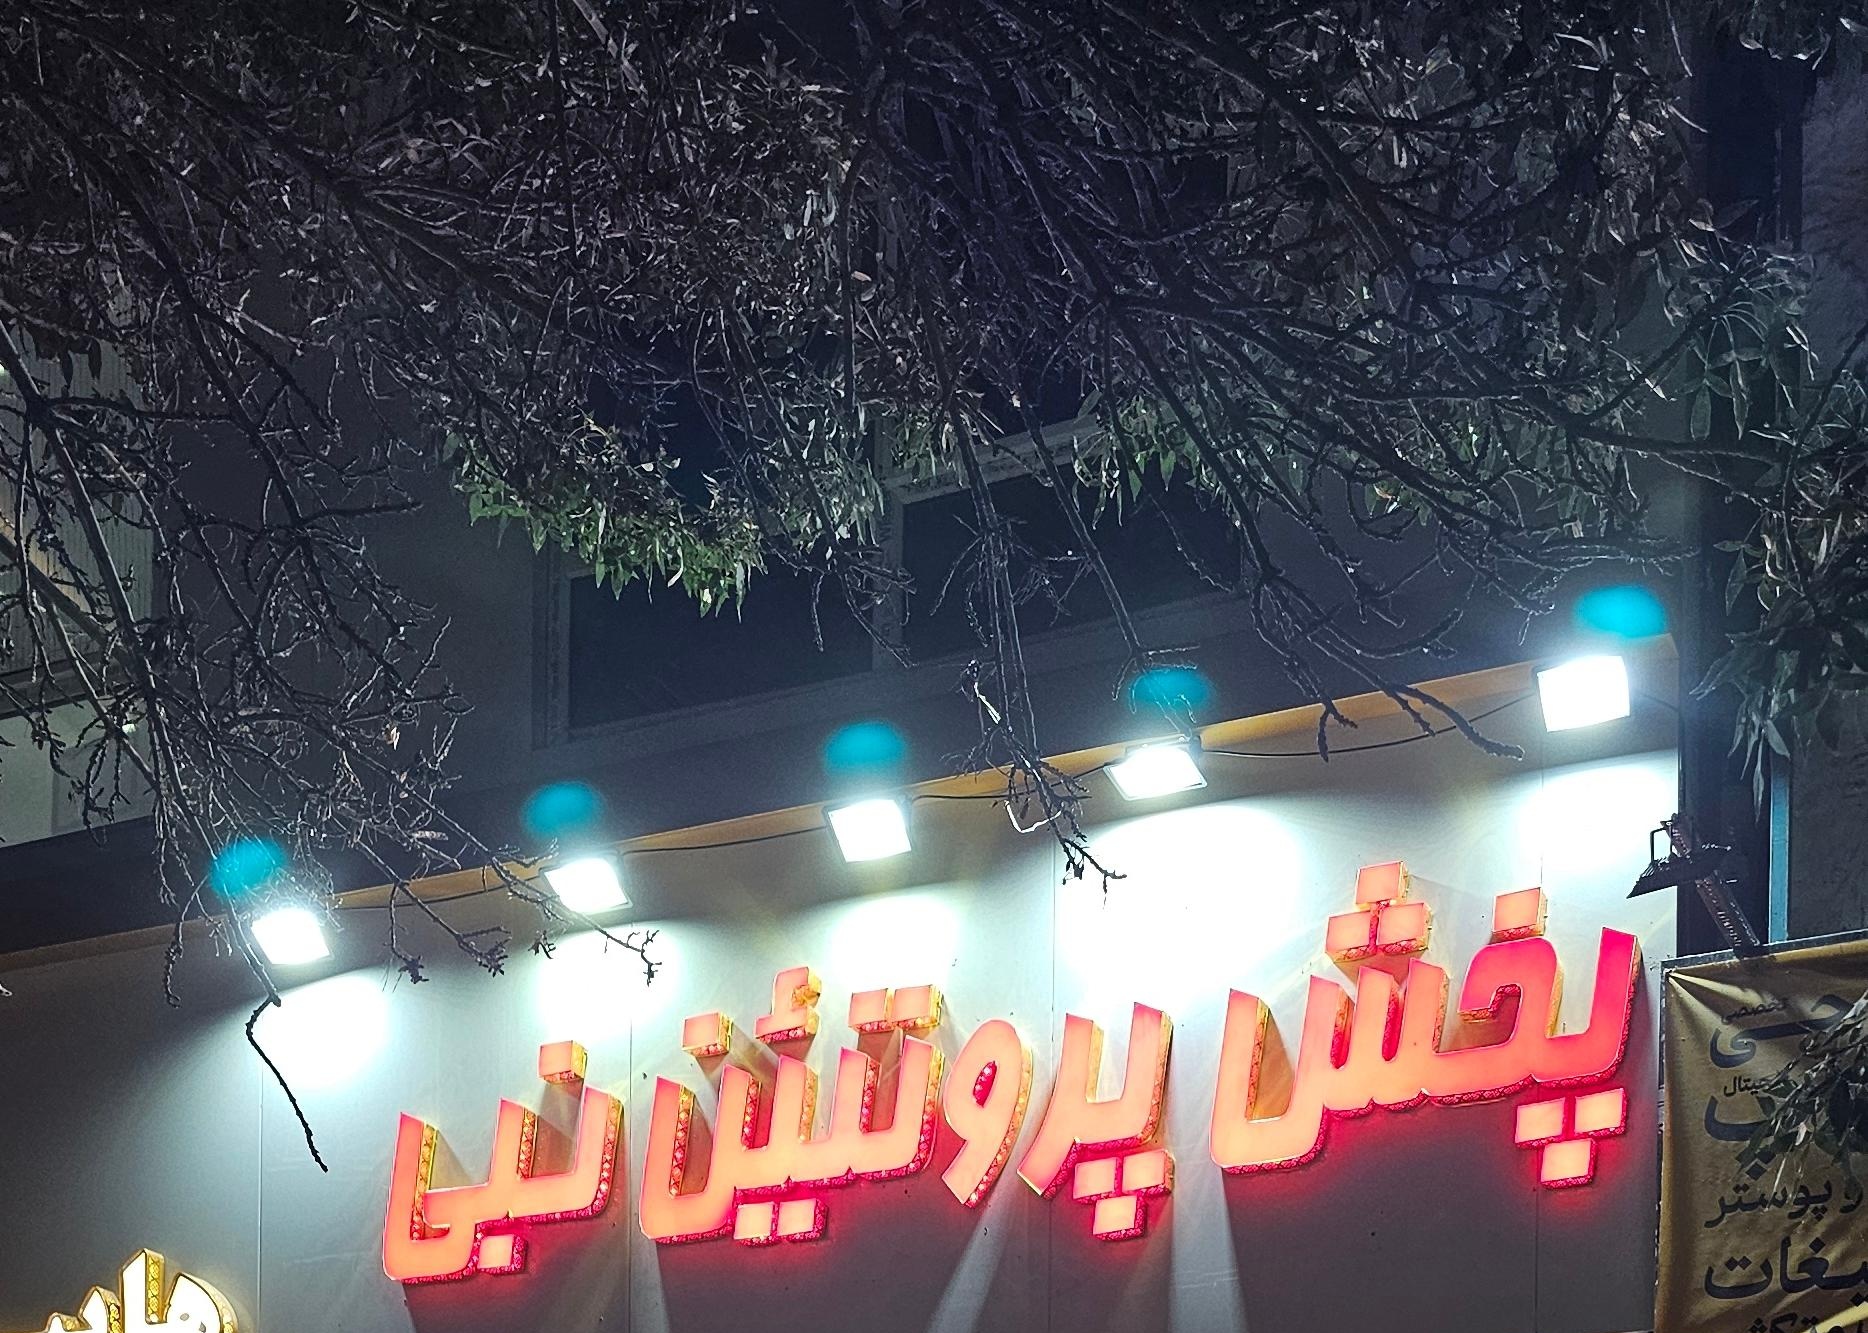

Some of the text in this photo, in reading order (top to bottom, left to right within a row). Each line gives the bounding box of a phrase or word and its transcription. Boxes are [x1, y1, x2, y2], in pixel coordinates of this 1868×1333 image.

[383, 860, 1641, 1283] پخش پروتئین نبی
[1704, 1179, 1832, 1229] پوستر
